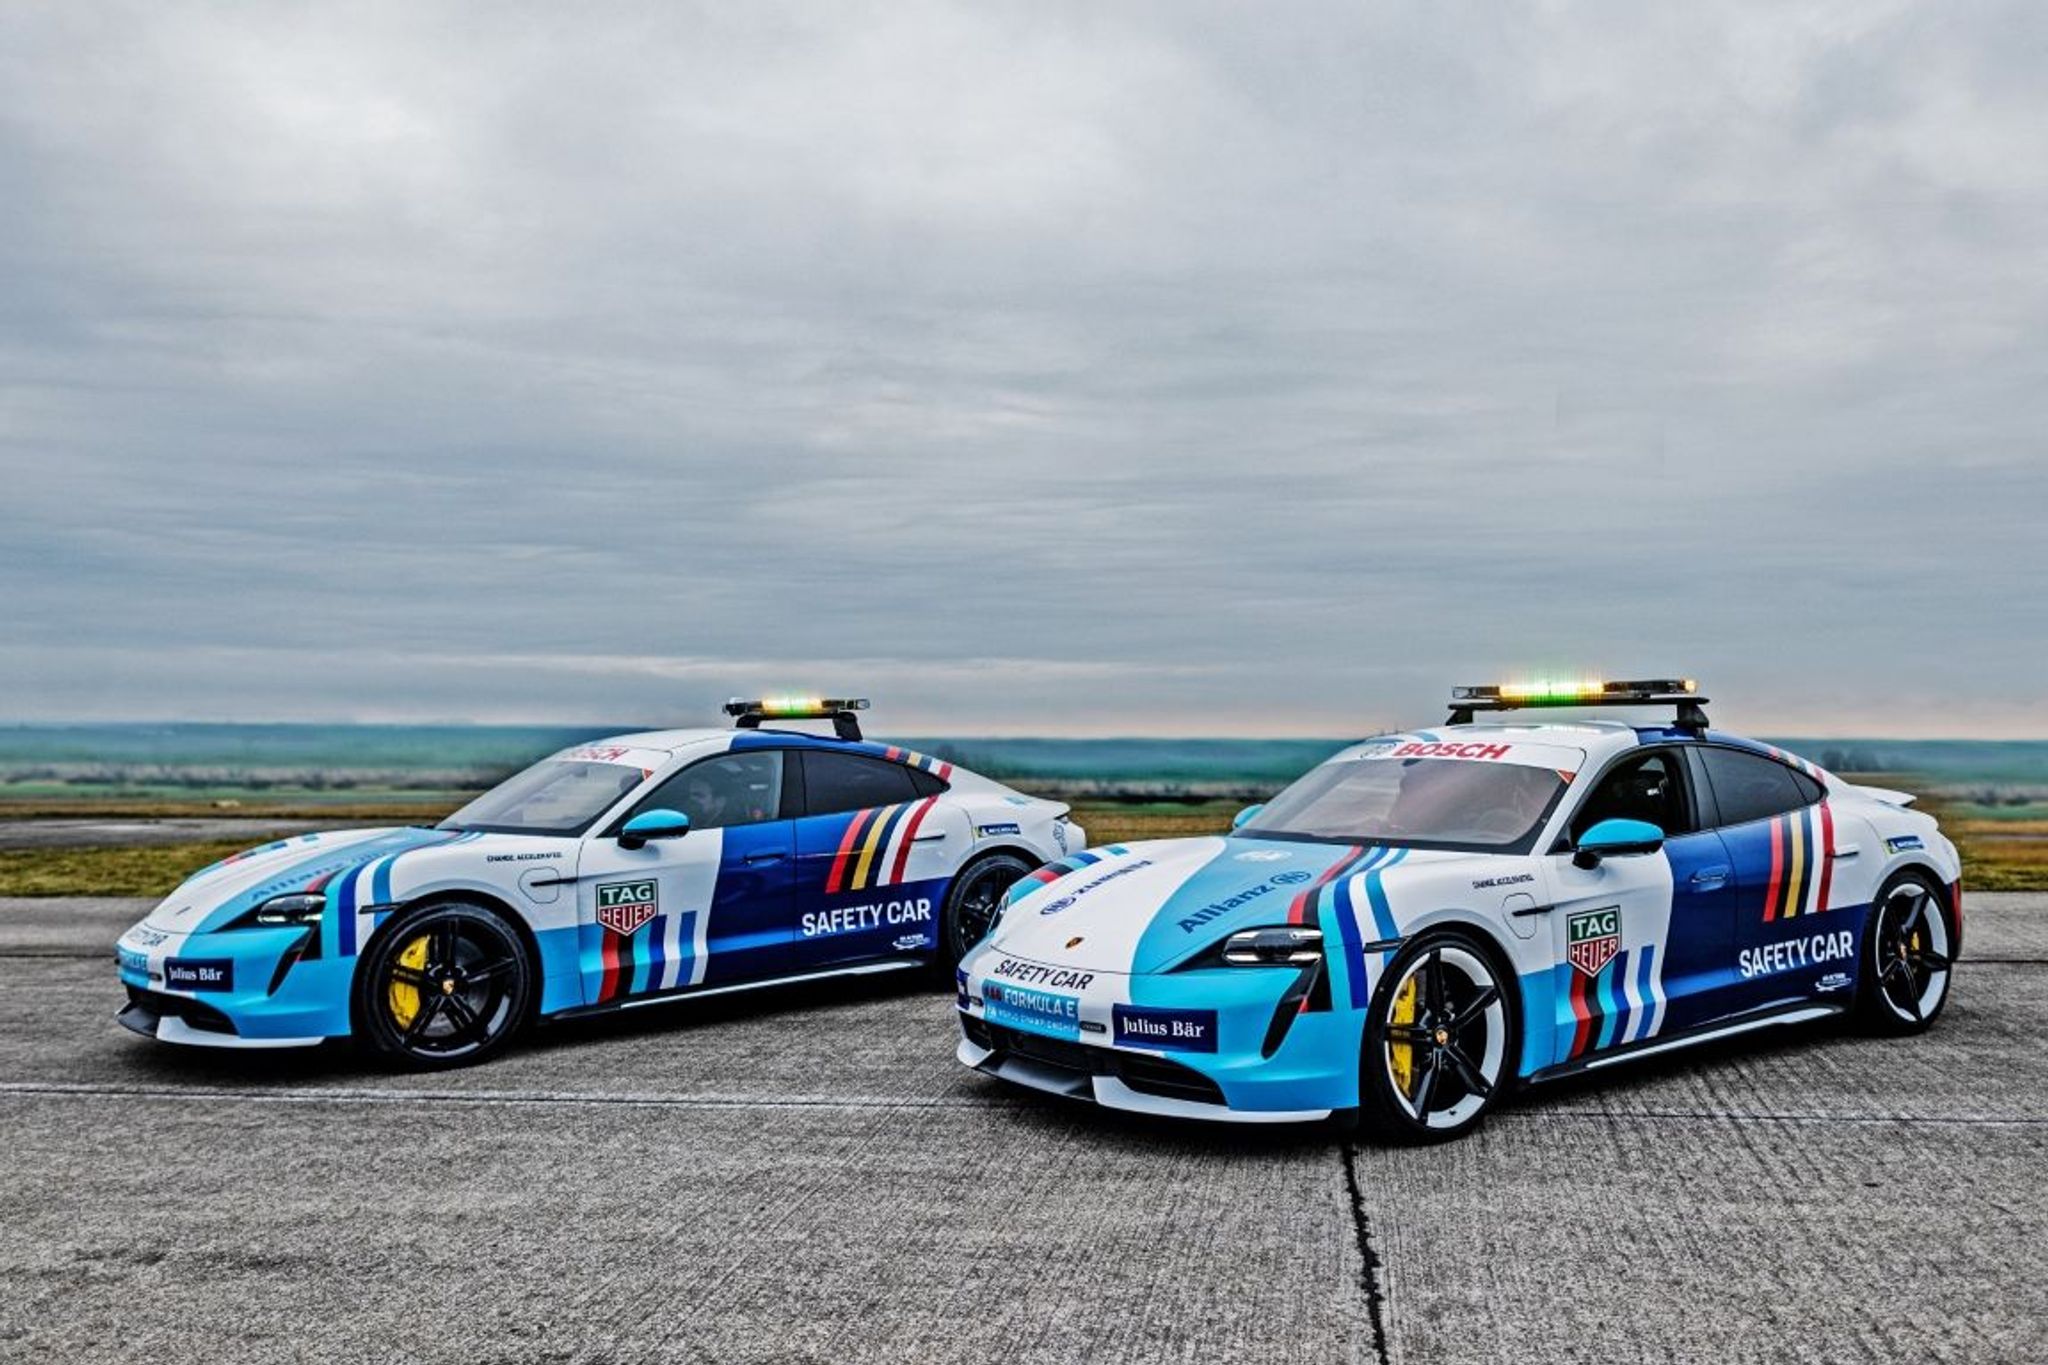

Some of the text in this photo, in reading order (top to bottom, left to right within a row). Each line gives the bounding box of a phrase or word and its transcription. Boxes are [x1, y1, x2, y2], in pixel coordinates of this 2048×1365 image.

[1393, 743, 1512, 759] BOSCH
[602, 885, 651, 904] TAG
[601, 905, 653, 931] HEUER
[801, 898, 931, 936] SAFETY CAR
[1176, 883, 1276, 934] Allianz
[1573, 916, 1615, 939] TAG
[1571, 939, 1617, 973] HEUER
[1739, 930, 1854, 978] SAFETY CAR
[199, 966, 223, 981] Bär
[993, 959, 1094, 990] SAFETY CAR
[1004, 988, 1075, 1017] FORMULA E
[1123, 1016, 1168, 1036] Julius
[1171, 1020, 1204, 1038] Bär
